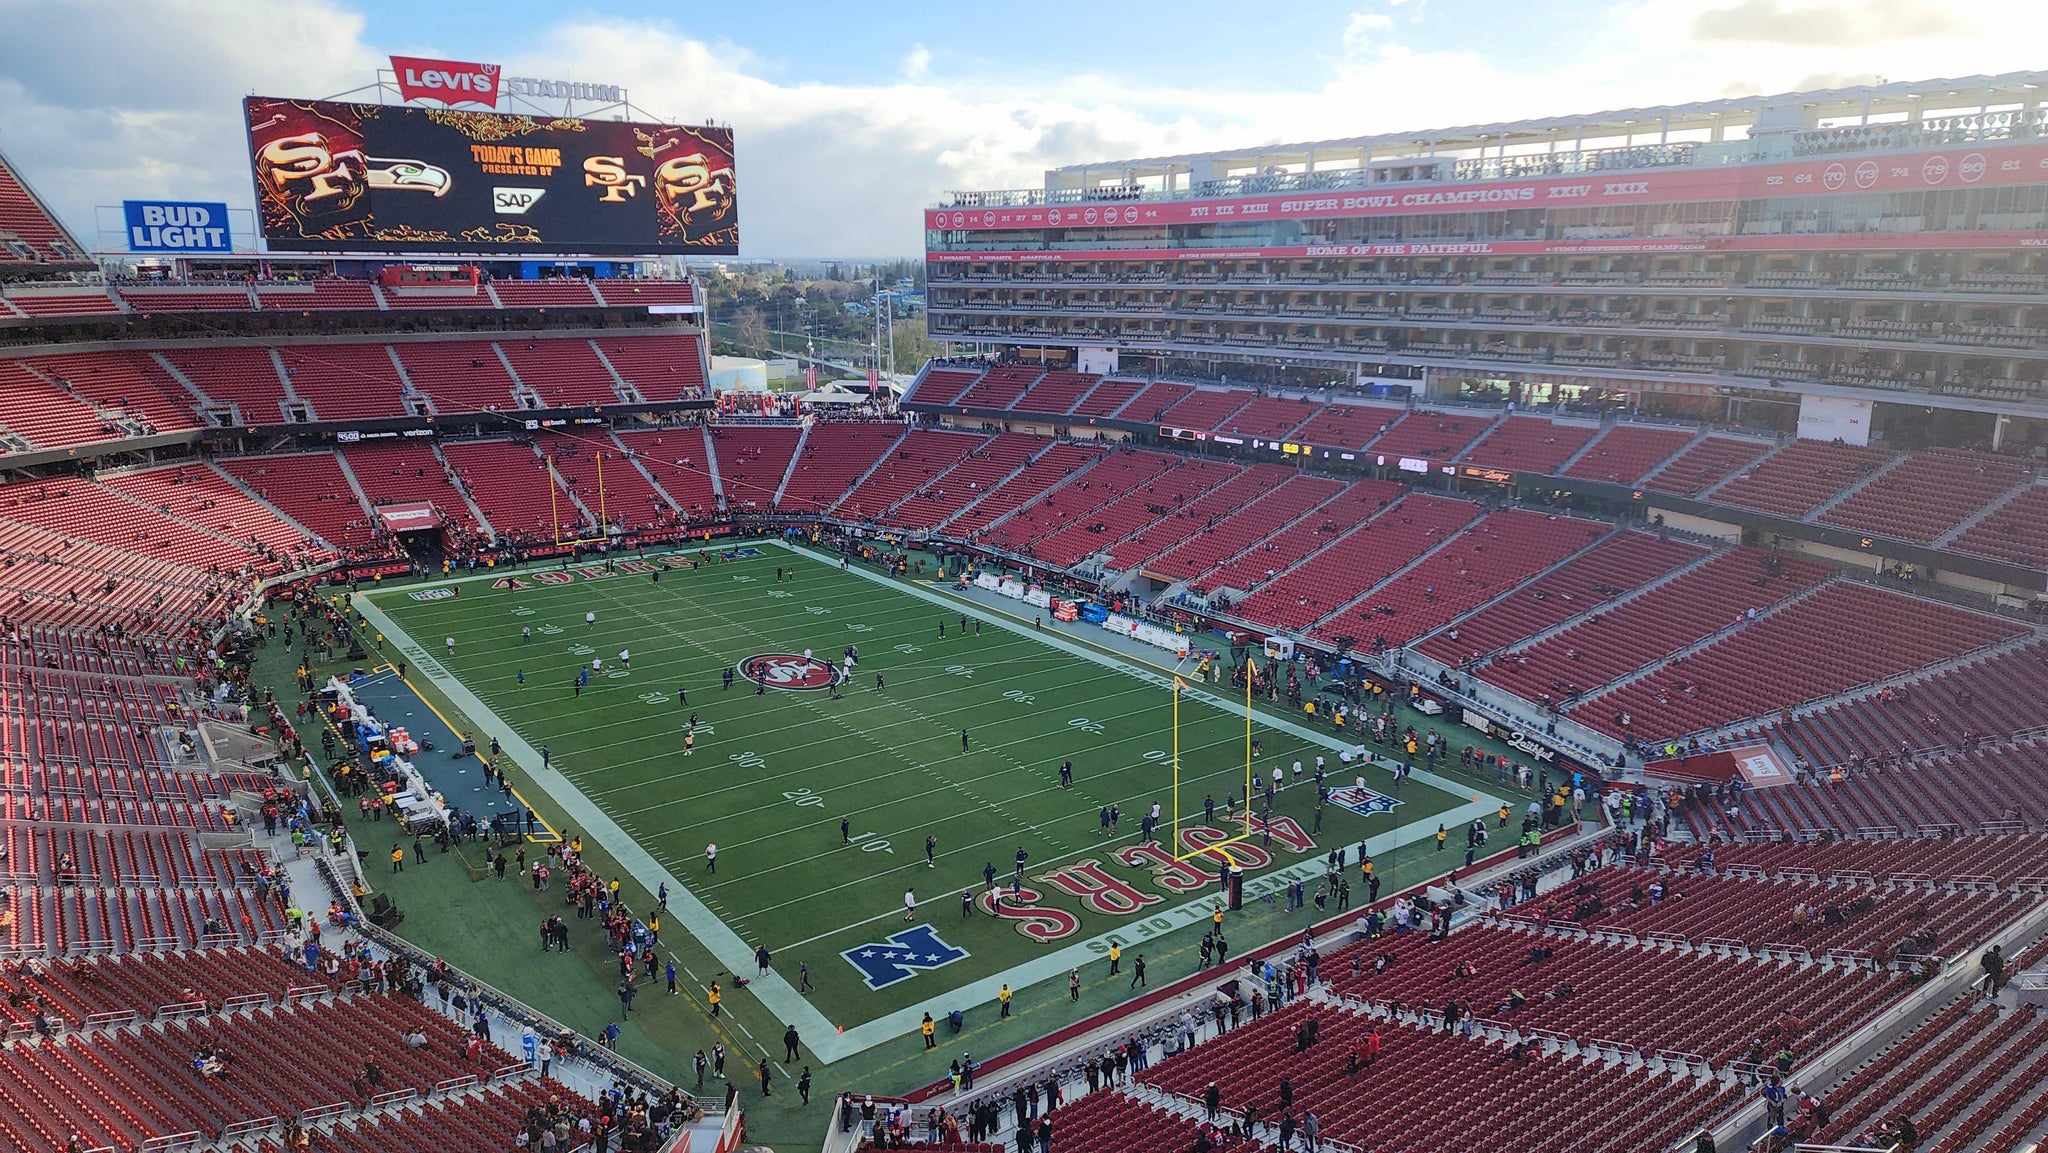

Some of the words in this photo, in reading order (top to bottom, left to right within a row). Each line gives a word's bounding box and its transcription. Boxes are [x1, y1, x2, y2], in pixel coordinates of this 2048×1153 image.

[508, 77, 620, 102] STADIUM
[471, 145, 522, 164] TODAY'S
[525, 148, 561, 167] GAME
[482, 164, 537, 176] PRESENTED
[540, 167, 552, 176] BY
[1795, 174, 1812, 183] 64
[1891, 167, 1909, 176] 74
[1924, 165, 1946, 175] 79
[1766, 176, 1783, 185] 52
[496, 193, 532, 207] SAP
[1190, 206, 1209, 216] XVI
[1215, 205, 1234, 215] XIX
[1241, 203, 1269, 214] XXIII
[1281, 199, 1338, 212] SUPER
[1343, 196, 1398, 209] BOWL
[1402, 188, 1535, 206] CHAMPIONS
[1548, 185, 1592, 198] XXIV
[1603, 182, 1648, 195] XXIX
[142, 206, 210, 226] BUD
[1306, 247, 1347, 256] HOME
[1351, 246, 1370, 255] OF
[1374, 245, 1404, 254] THE
[1410, 244, 1493, 254] FAITHFUL
[403, 429, 433, 437] verizon
[1398, 458, 1428, 472] 49ERS
[491, 555, 696, 590] 49ERS
[1003, 690, 1036, 703] 30
[1068, 718, 1105, 733] 20
[1462, 708, 1489, 734] HOME
[1507, 732, 1554, 763] Faithful
[729, 751, 765, 768] 30
[782, 788, 822, 806] 20
[847, 831, 890, 852] 10
[968, 810, 1319, 942] 49ERS
[1242, 865, 1314, 898] TAKES
[1136, 919, 1173, 937] OF
[1086, 933, 1126, 954] US
[890, 1113, 895, 1121] 9
